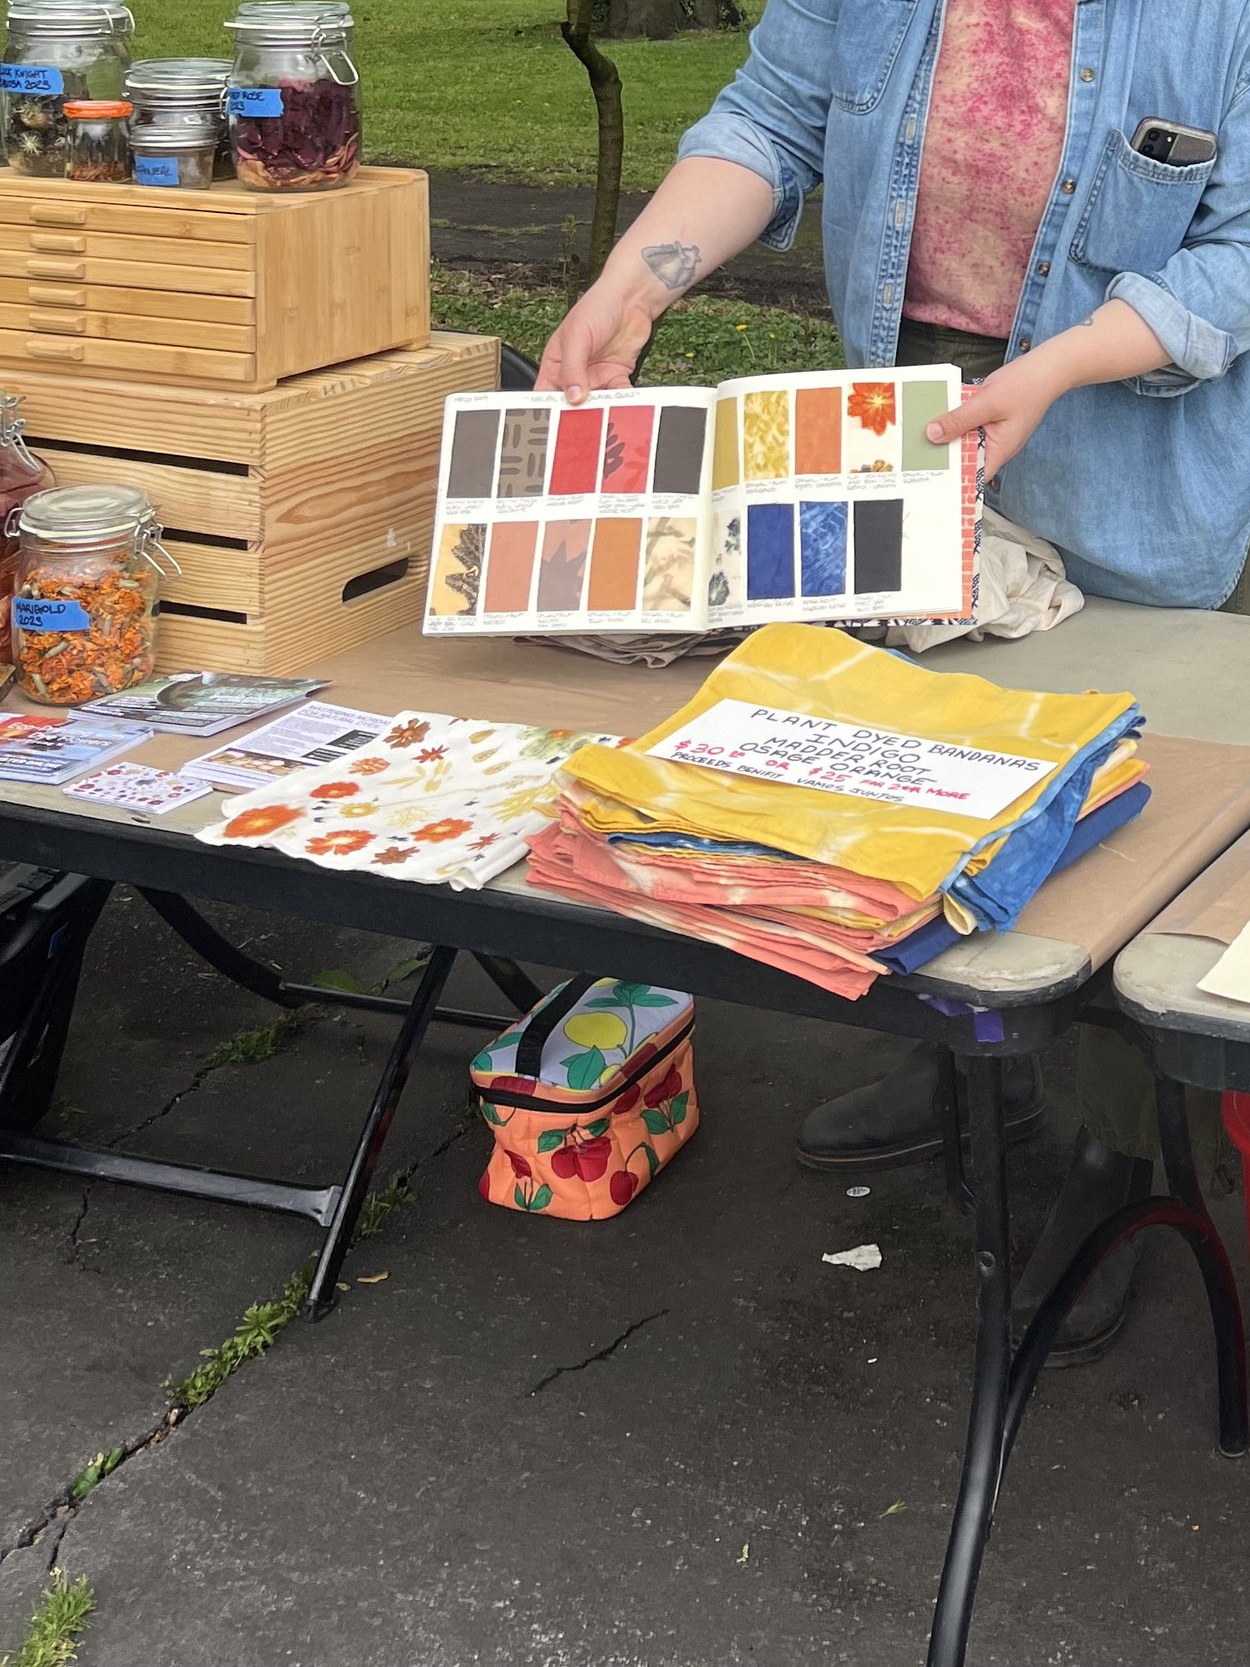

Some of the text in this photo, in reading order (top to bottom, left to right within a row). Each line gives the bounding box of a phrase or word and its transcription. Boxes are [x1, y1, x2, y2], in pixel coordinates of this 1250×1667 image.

[16, 603, 66, 615] MARIGOLD
[19, 615, 43, 627] 2023
[750, 708, 1041, 772] PLANT DYED BANDANAS
[763, 736, 932, 775] MADDER ROOT
[805, 733, 921, 764] INDIGO
[670, 751, 905, 802] PROCEEDS BENIFIT VAMOS JUNTOS
[674, 738, 725, 756] $30
[765, 759, 791, 771] OR
[807, 766, 853, 783] $25
[925, 787, 972, 801] MORE
[739, 742, 938, 786] OSAGE ORANGE
